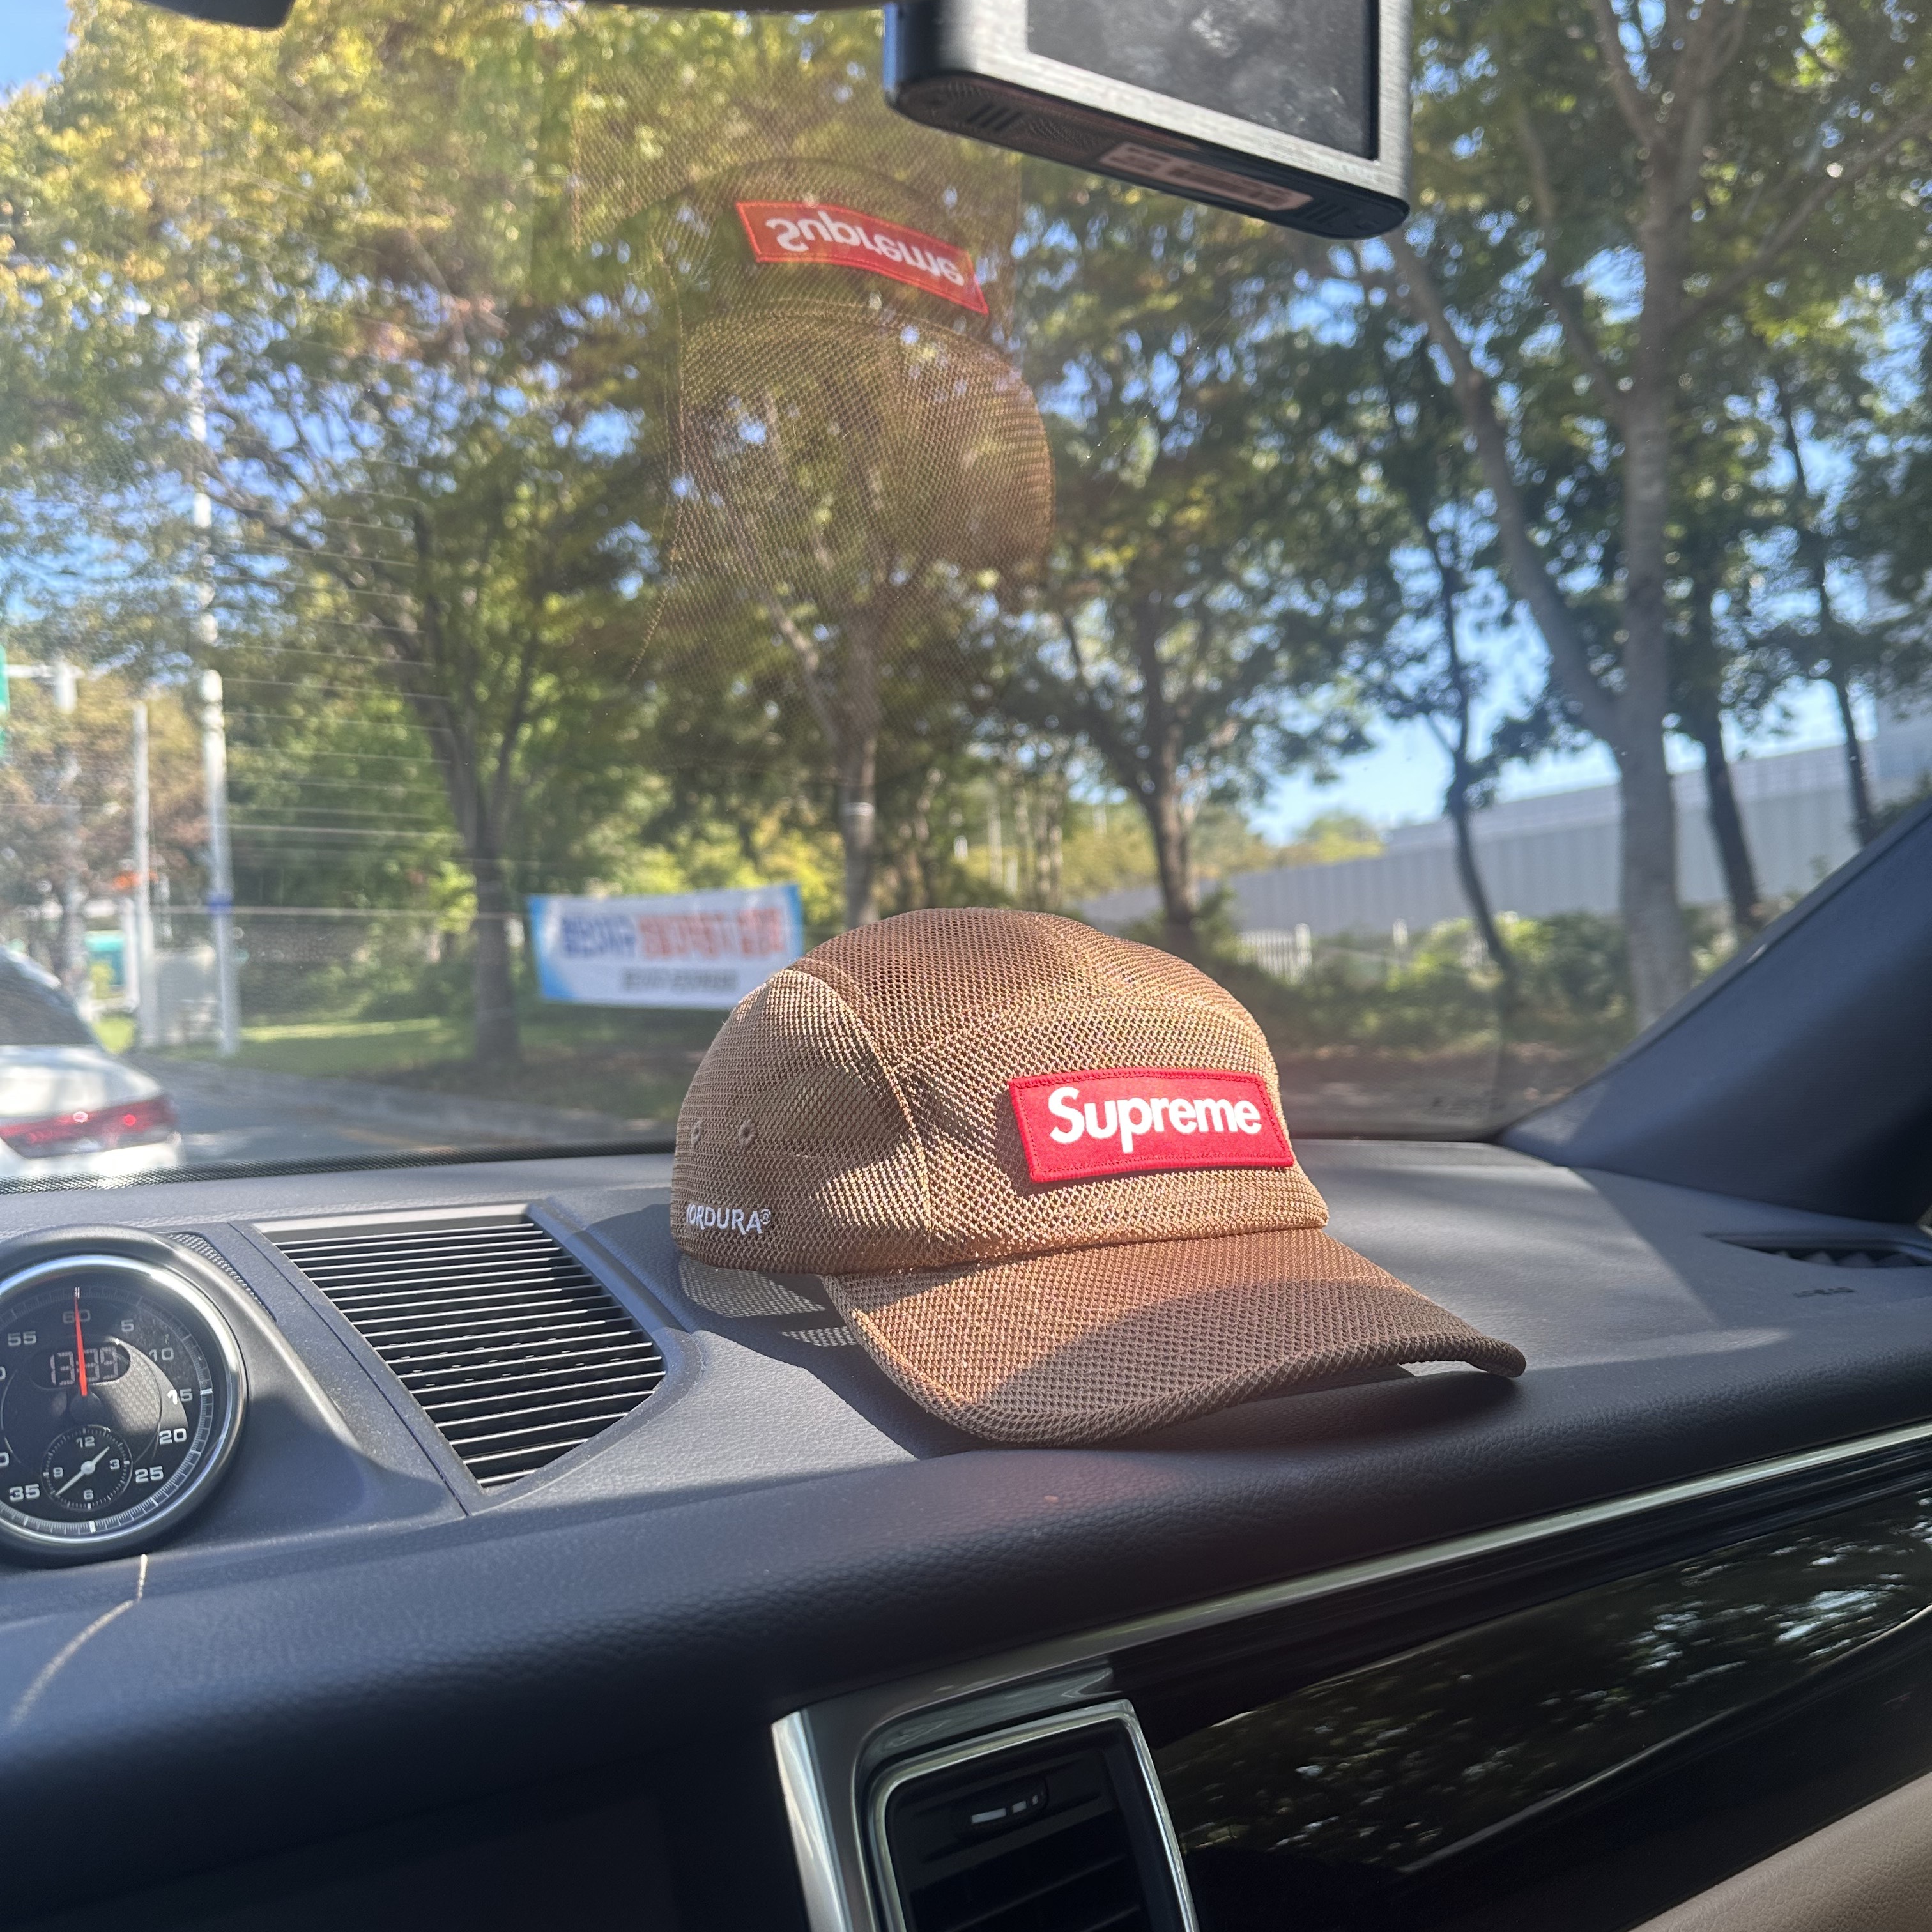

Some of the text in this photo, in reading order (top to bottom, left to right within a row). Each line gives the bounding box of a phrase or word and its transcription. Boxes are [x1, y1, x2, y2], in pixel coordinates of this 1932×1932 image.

[1048, 1087, 1262, 1153] Supreme
[63, 1310, 91, 1324] 60
[121, 1319, 134, 1332] 5
[8, 1331, 37, 1346] 55
[149, 1347, 174, 1361] 10
[167, 1388, 193, 1405] 15
[76, 1436, 95, 1448] 12
[159, 1428, 187, 1445] 20
[109, 1459, 121, 1470] 3
[53, 1467, 64, 1478] 9
[135, 1466, 164, 1483] 25
[9, 1483, 40, 1501] 35
[83, 1489, 94, 1500] 6
